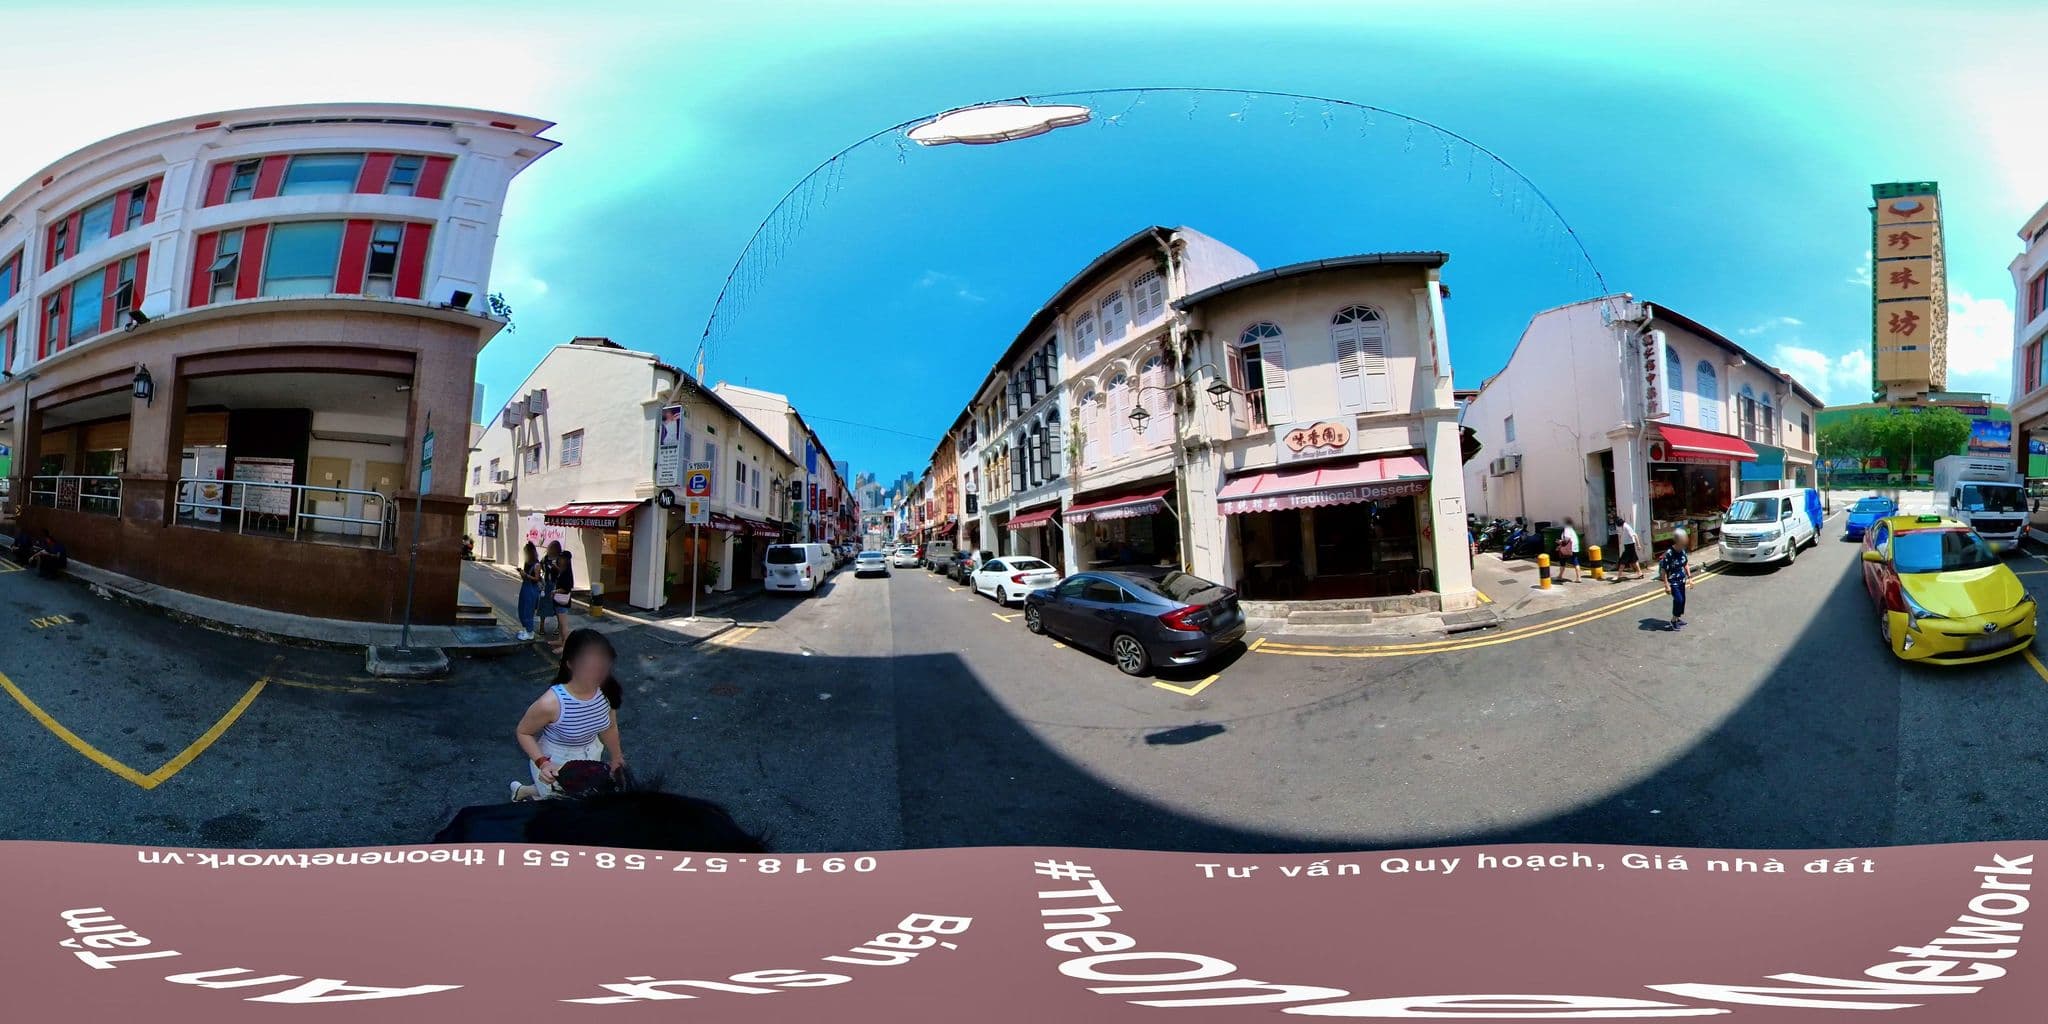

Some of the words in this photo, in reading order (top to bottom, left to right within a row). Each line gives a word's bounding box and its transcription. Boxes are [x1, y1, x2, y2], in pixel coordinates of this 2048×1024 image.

[1888, 231, 1923, 337] 珍珠坊
[1289, 488, 1358, 506] Traditional
[1362, 482, 1423, 498] Desserts
[584, 519, 616, 527] JEWELLERY
[30, 614, 75, 629] TAXI
